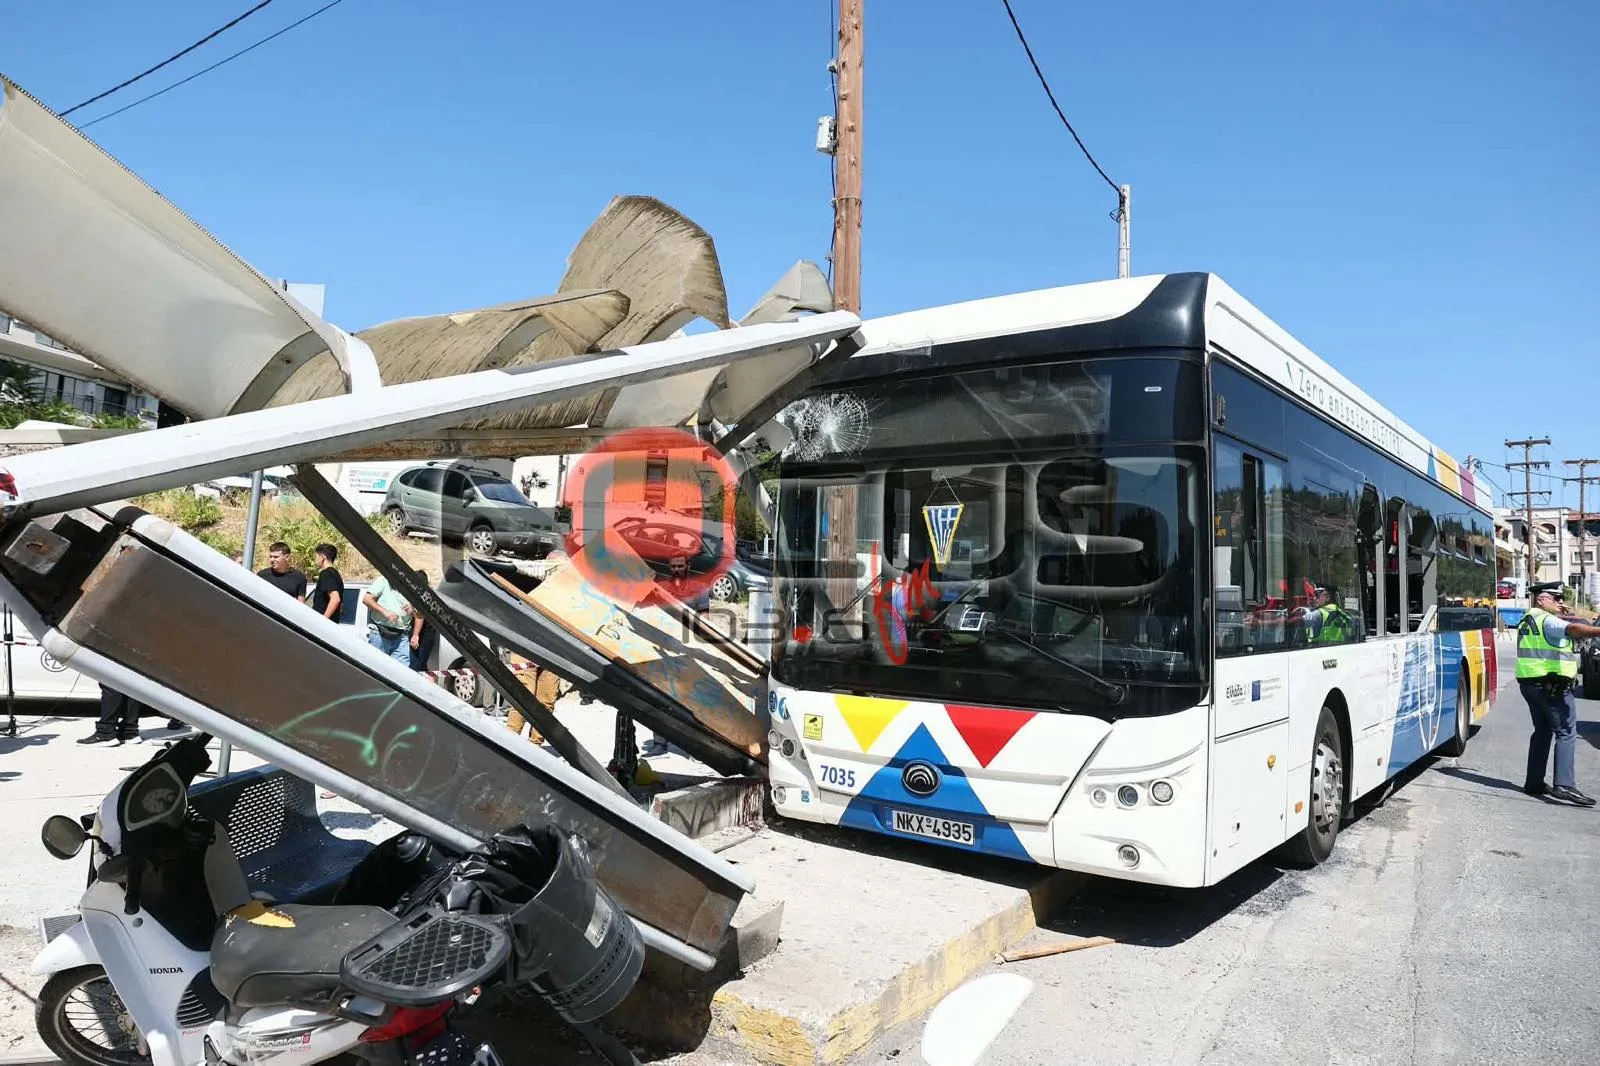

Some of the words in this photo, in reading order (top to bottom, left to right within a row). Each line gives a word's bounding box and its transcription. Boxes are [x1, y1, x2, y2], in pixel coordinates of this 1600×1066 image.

[1299, 367, 1324, 405] Zero
[1329, 395, 1370, 433] emission
[820, 764, 856, 788] 7035
[150, 967, 184, 975] HONDA
